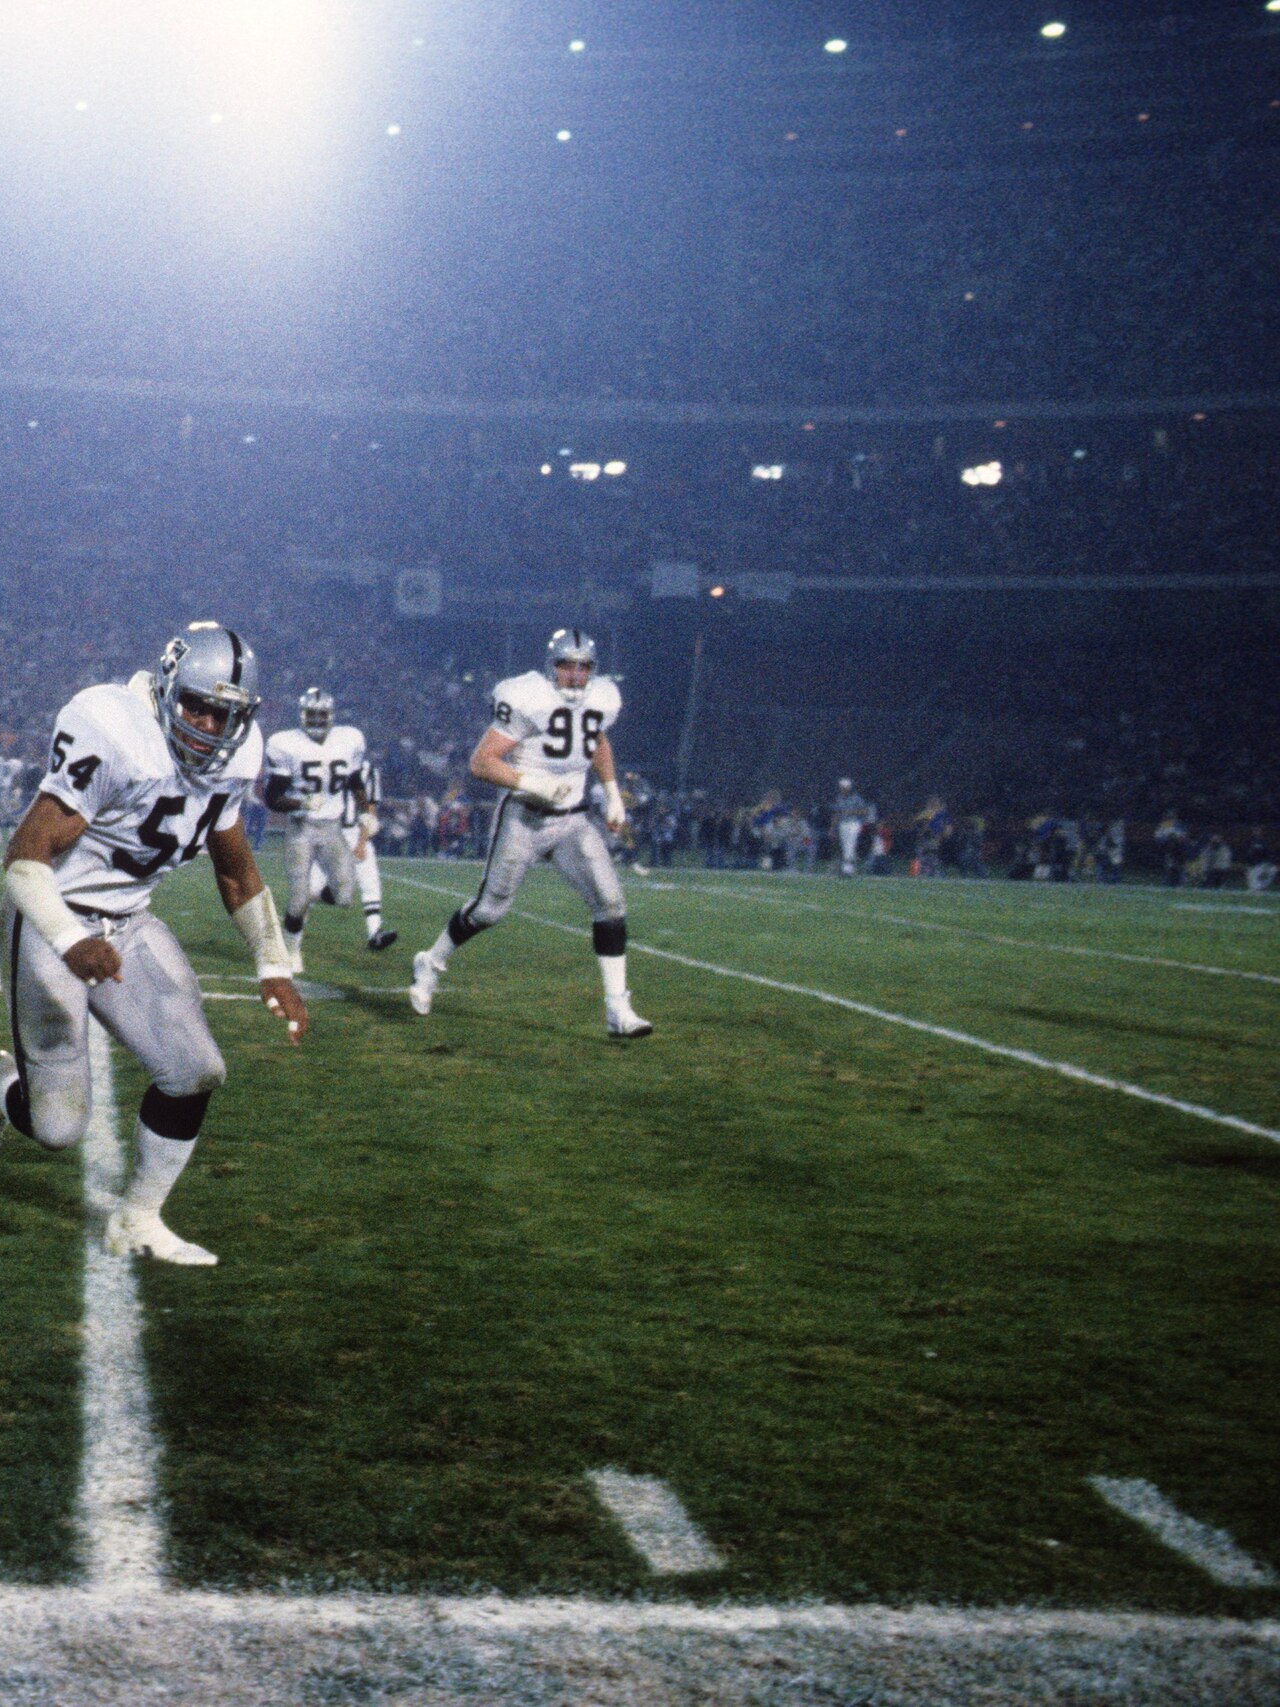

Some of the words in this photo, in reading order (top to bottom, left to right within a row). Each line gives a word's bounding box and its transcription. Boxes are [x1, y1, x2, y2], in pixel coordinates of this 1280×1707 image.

[490, 698, 513, 723] 8
[543, 707, 604, 759] 98
[51, 731, 102, 791] 54
[300, 760, 348, 795] 56
[112, 793, 231, 879] 54
